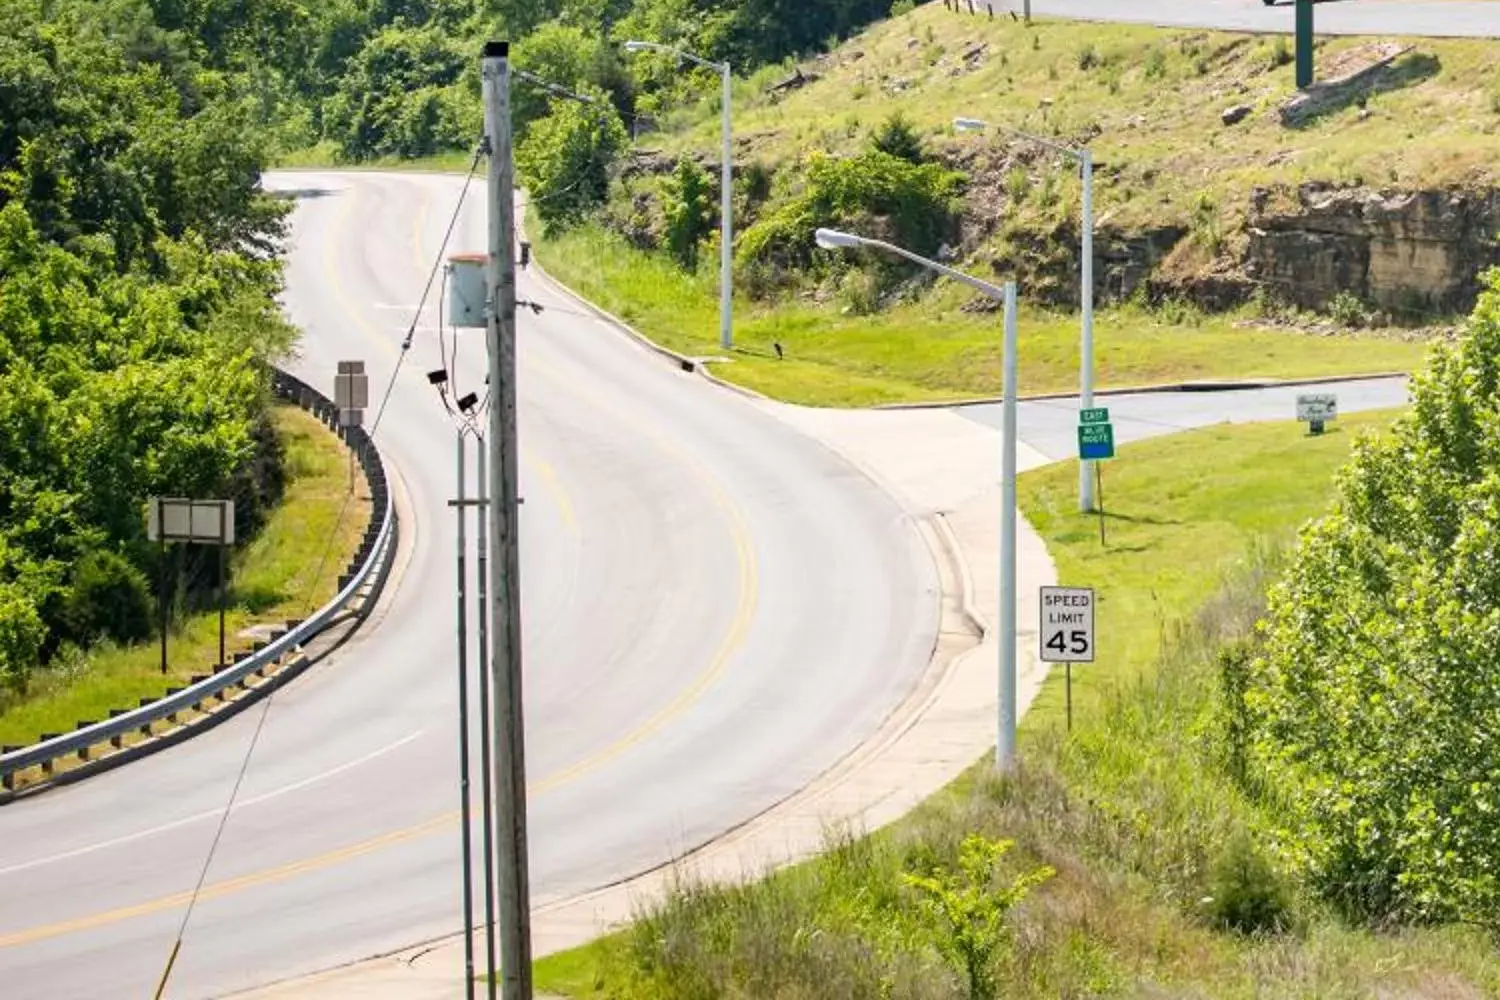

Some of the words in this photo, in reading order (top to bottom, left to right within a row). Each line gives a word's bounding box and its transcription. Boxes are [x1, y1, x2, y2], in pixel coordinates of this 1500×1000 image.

[1045, 595, 1089, 607] SPEED
[1049, 612, 1085, 624] LIMIT
[1045, 630, 1089, 655] 45
